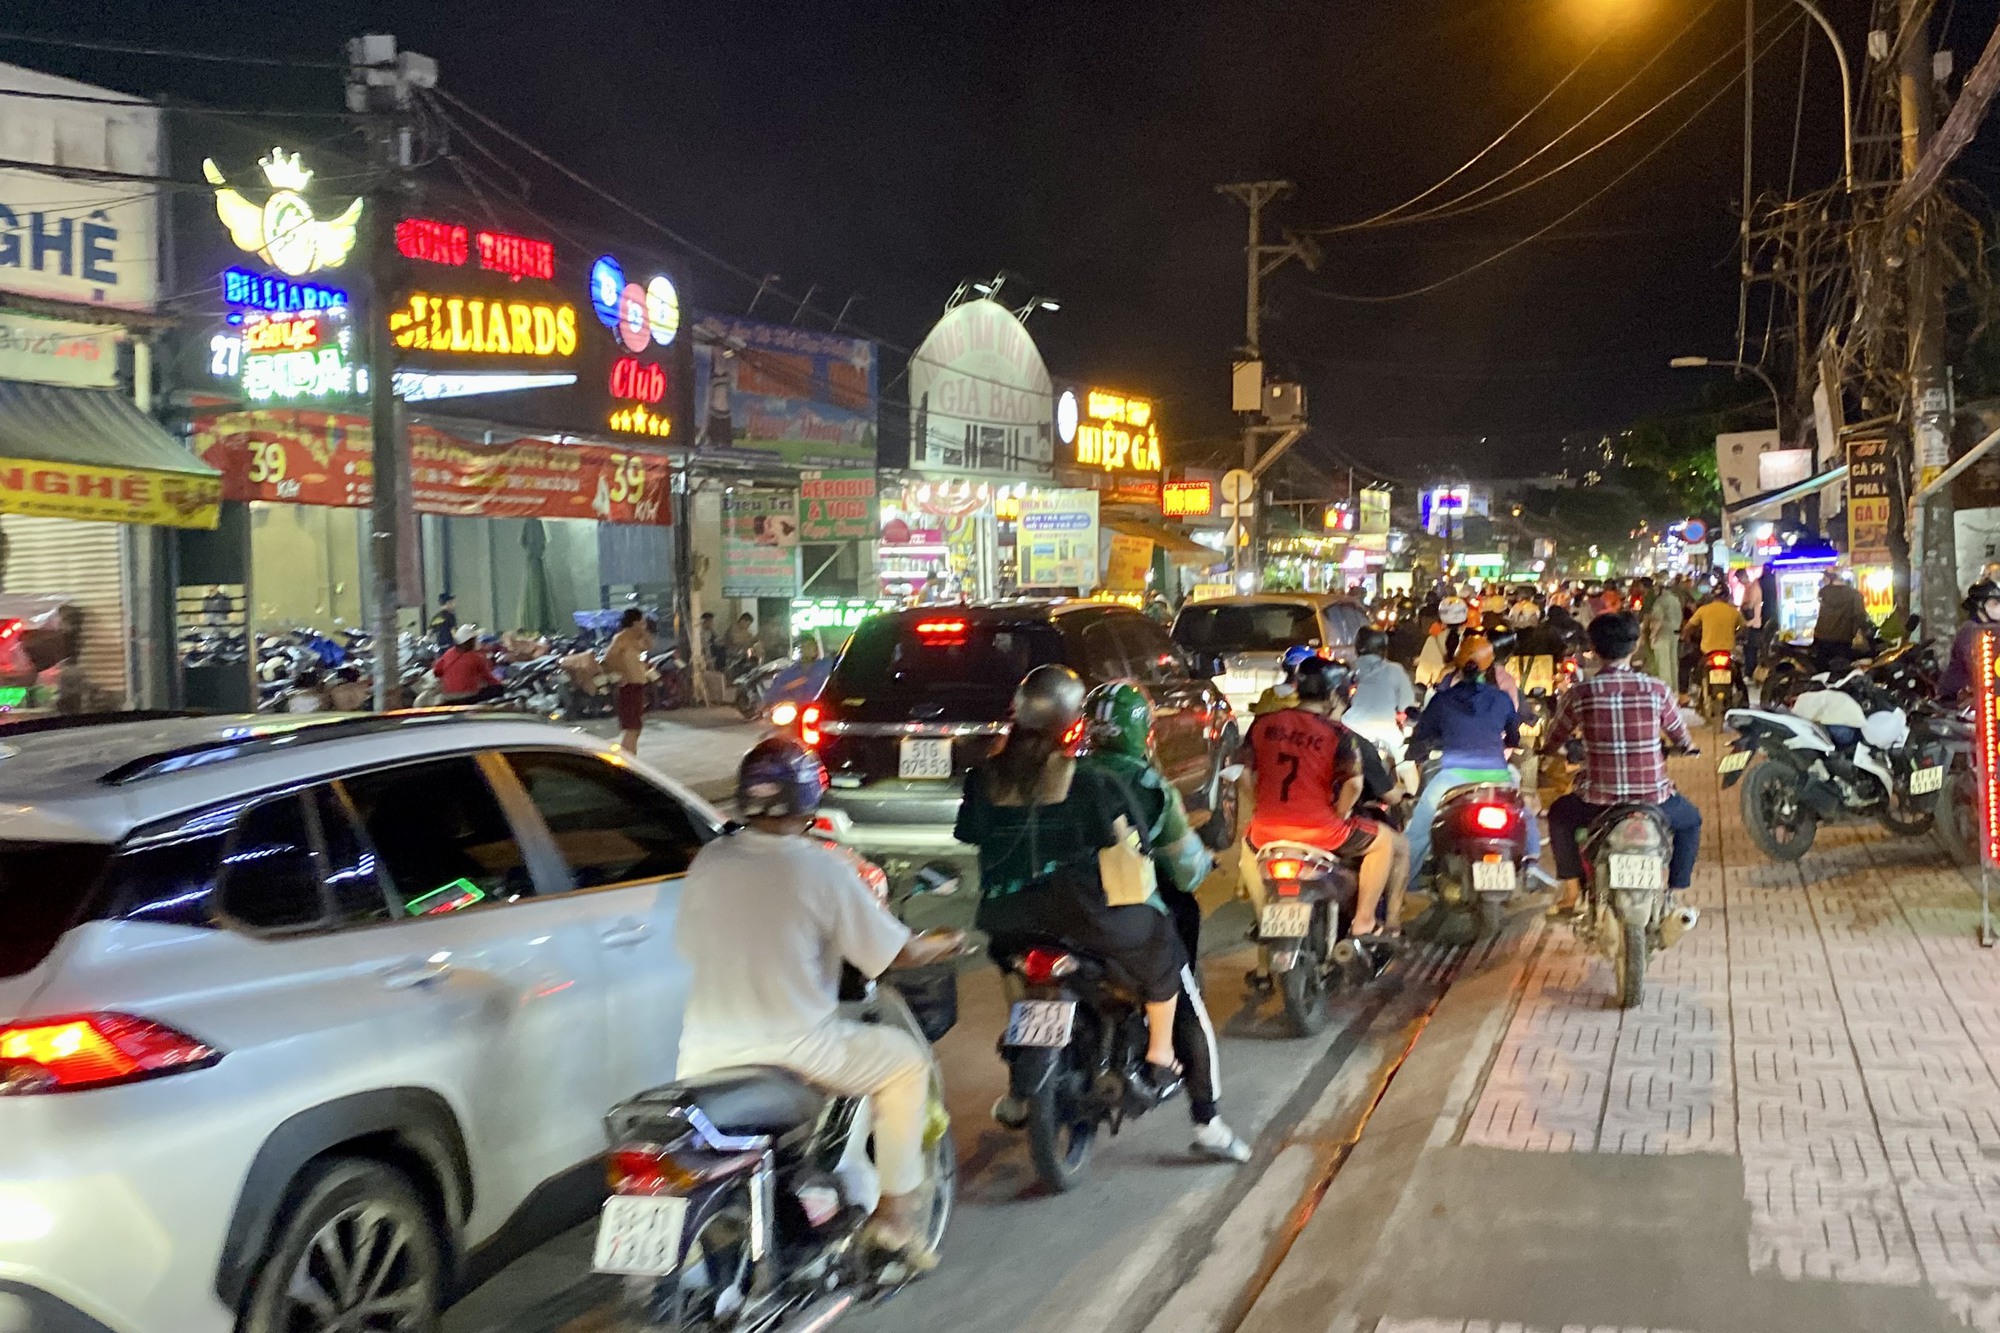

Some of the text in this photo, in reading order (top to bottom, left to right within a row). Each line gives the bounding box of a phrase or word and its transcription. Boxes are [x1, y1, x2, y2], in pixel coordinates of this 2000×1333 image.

[610, 357, 667, 404] Club
[247, 441, 287, 484] 39
[610, 453, 646, 504] 39
[801, 479, 876, 499] AEROBIC
[825, 500, 868, 520] YOGA
[1277, 751, 1300, 804] 7
